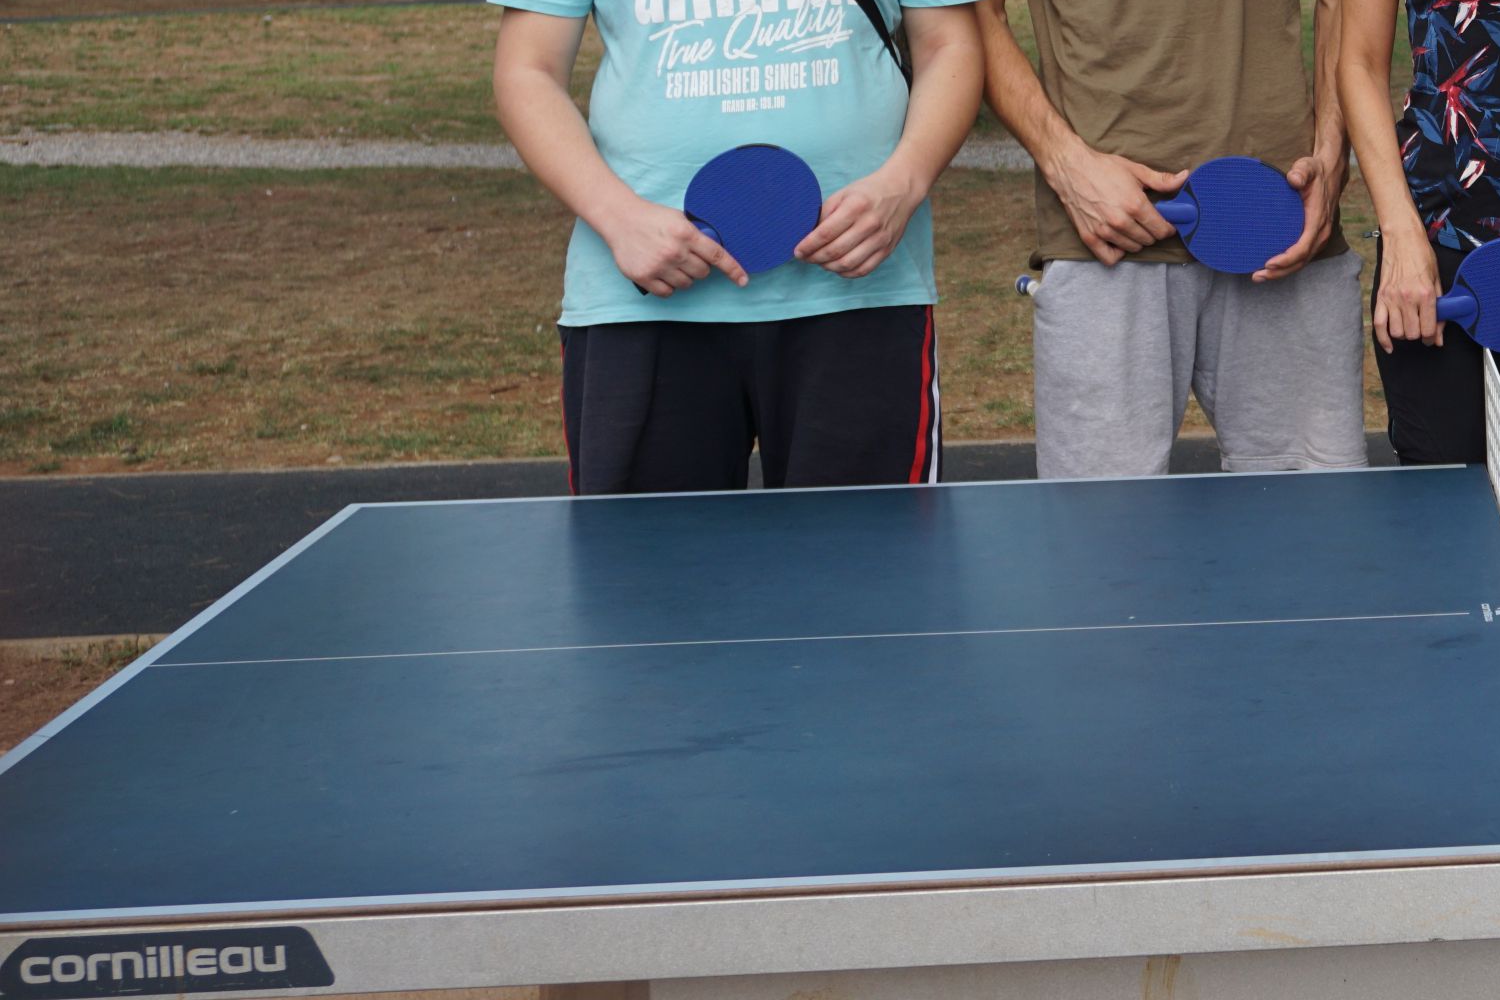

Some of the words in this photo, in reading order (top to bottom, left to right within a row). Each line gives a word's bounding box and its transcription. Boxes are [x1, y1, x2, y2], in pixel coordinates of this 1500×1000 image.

[649, 19, 716, 77] True
[665, 66, 760, 99] ESTABLISHED
[764, 61, 808, 92] SINCE
[20, 944, 287, 985] cornilleau
